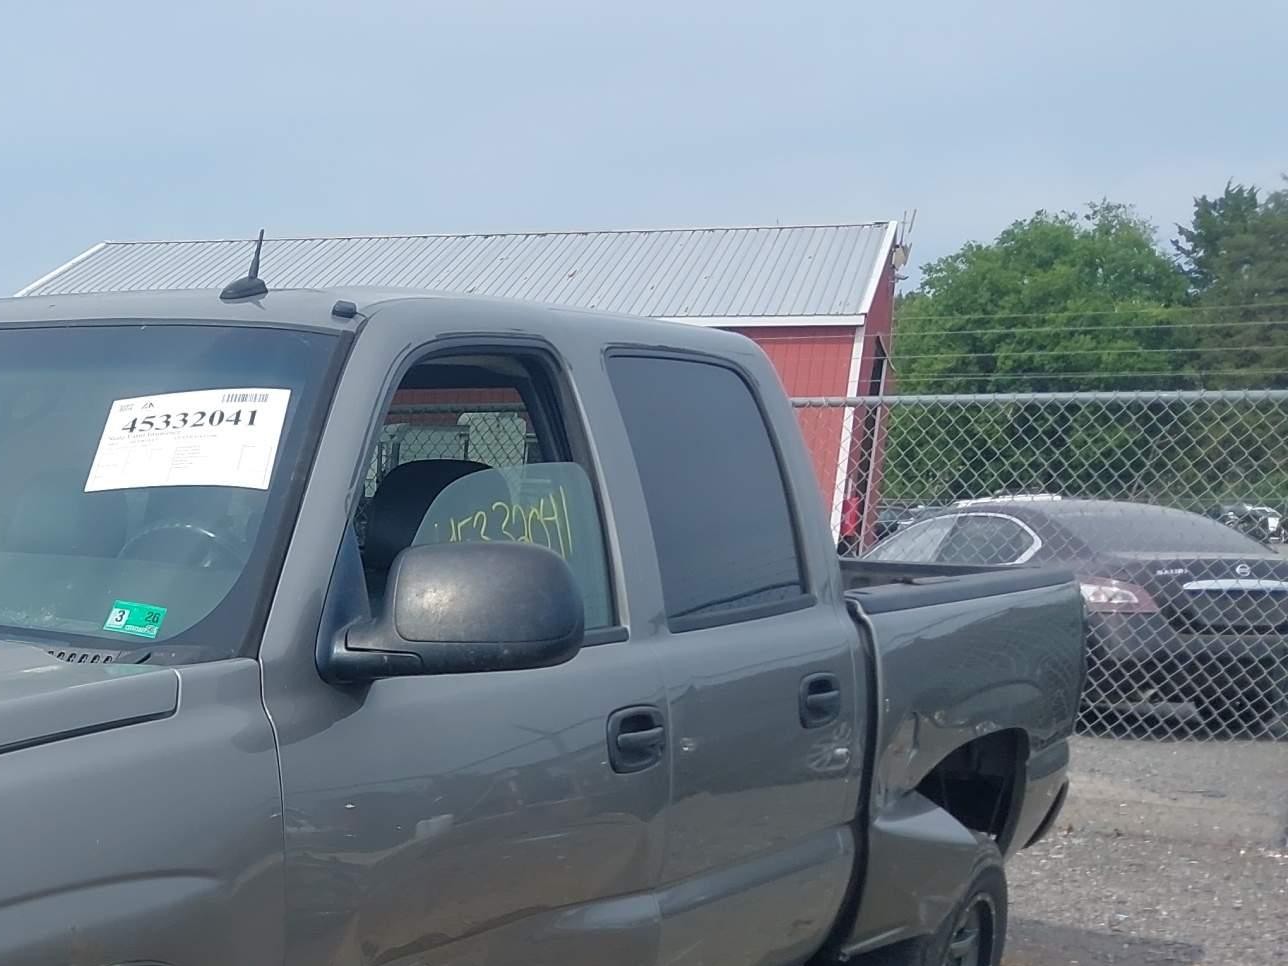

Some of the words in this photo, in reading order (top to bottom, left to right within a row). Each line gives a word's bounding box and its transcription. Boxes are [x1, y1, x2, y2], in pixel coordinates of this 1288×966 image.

[121, 409, 258, 433] 45332041
[115, 610, 126, 622] 3
[145, 611, 161, 624] 26
